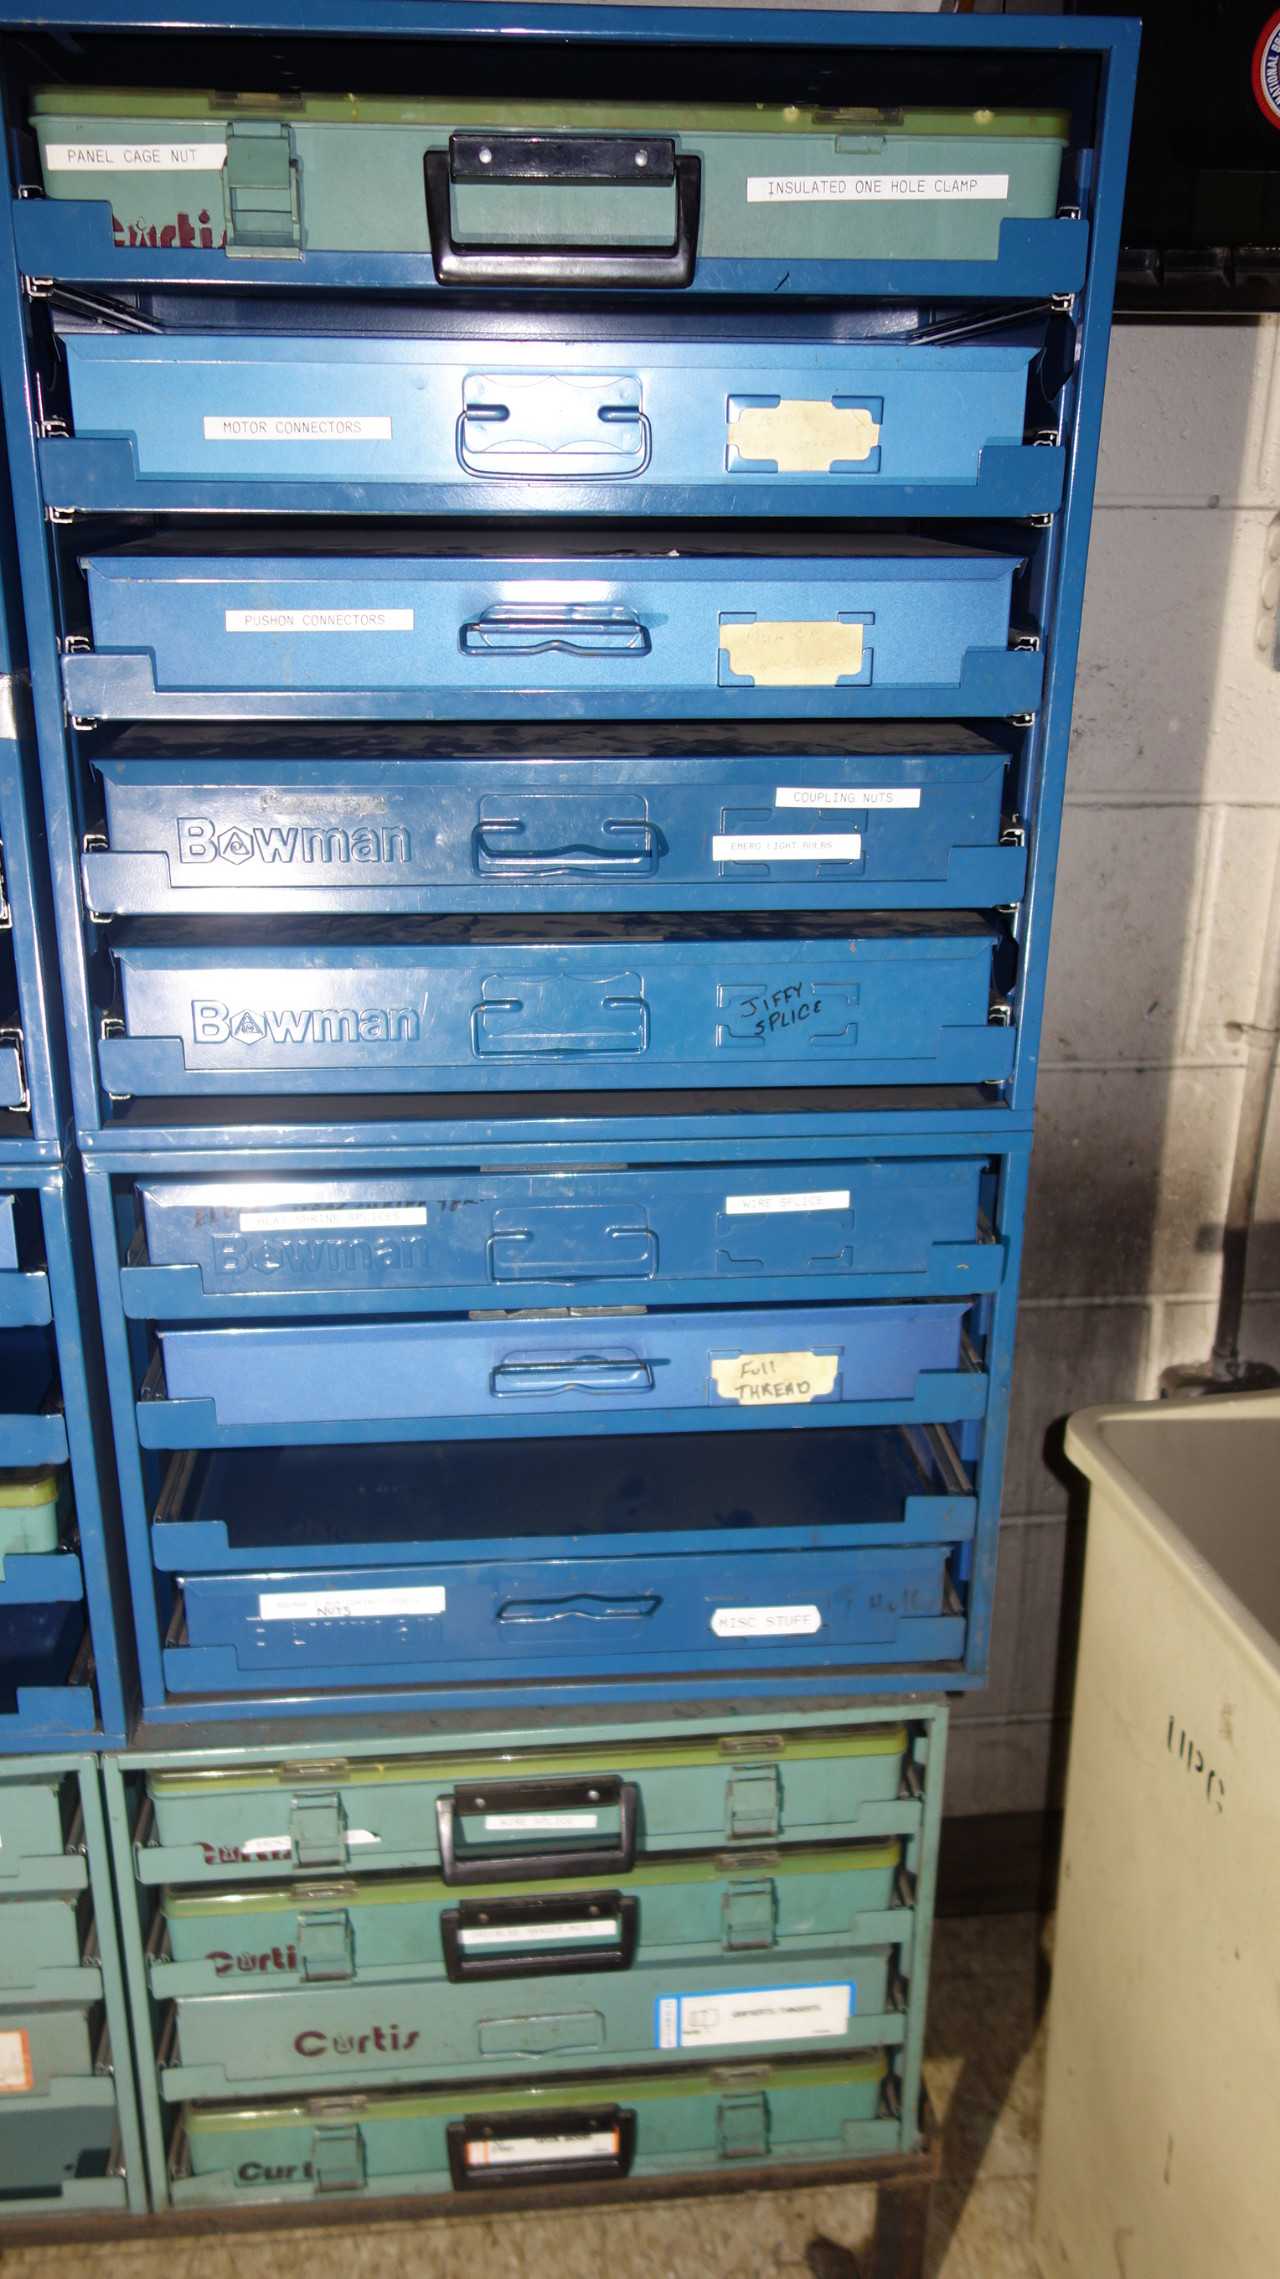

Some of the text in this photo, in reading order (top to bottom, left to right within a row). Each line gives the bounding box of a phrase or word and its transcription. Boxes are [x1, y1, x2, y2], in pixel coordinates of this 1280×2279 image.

[67, 149, 198, 164] PANEL CAGE NUT
[768, 179, 979, 195] INSULATED ONE HOLE CLAMP
[223, 420, 362, 434] MOTOR CONNECTORS
[244, 613, 386, 627] PUSHON CONNECTORS
[793, 791, 894, 804] COUPLING NUTS
[177, 817, 412, 866] Bowman
[740, 982, 805, 1018] JIFFY
[191, 1000, 420, 1045] Bowman
[754, 1001, 822, 1036] SPLICE
[735, 1377, 812, 1400] THREAD
[294, 2025, 420, 2058] Curtis
